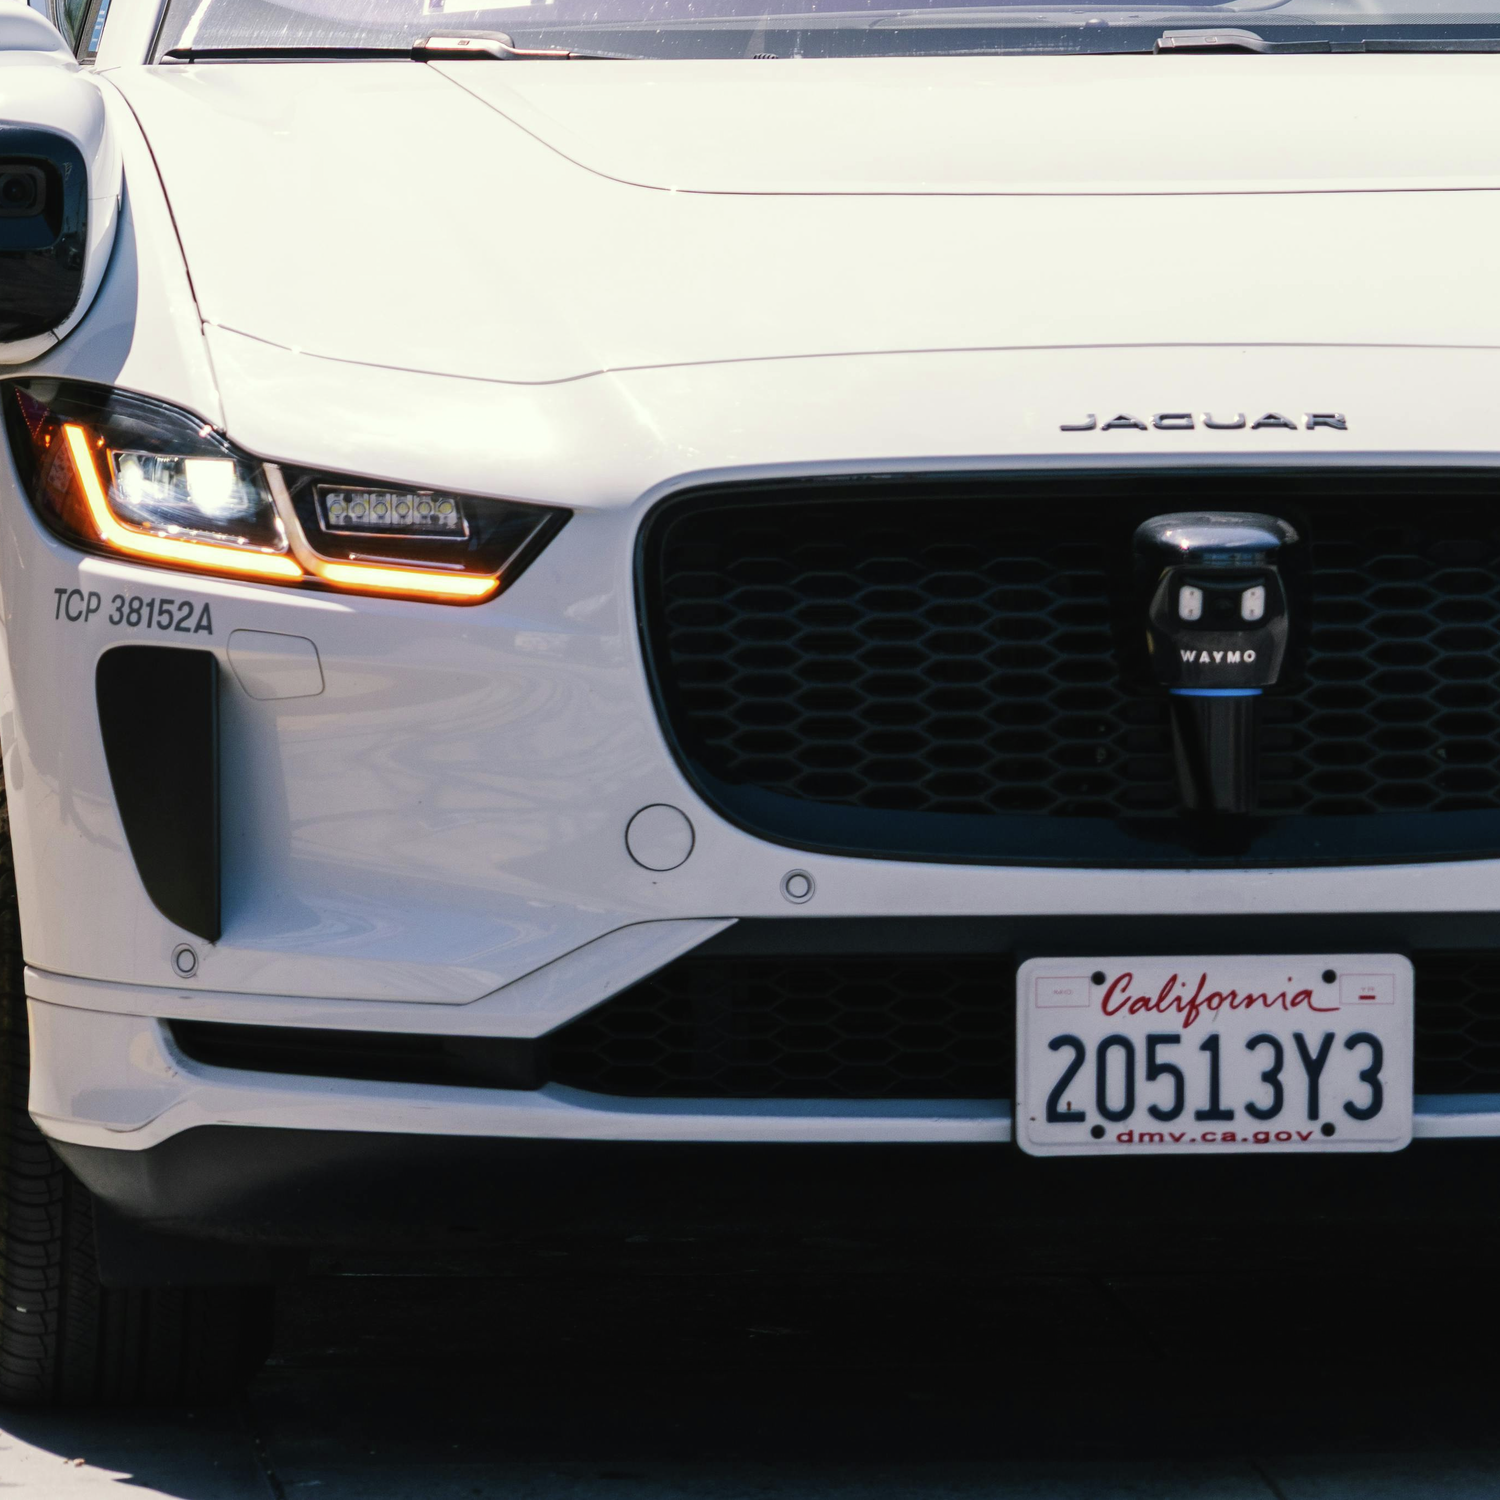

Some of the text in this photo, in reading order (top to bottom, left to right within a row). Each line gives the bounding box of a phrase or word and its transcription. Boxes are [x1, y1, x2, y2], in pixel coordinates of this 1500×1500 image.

[1059, 411, 1349, 432] JAGUAR
[54, 587, 214, 636] TCP 38152A
[1180, 649, 1257, 664] WAYMO
[1100, 971, 1341, 1029] California
[1045, 1031, 1384, 1124] 20513Y3
[1115, 1129, 1315, 1145] dmv.ca.gov
